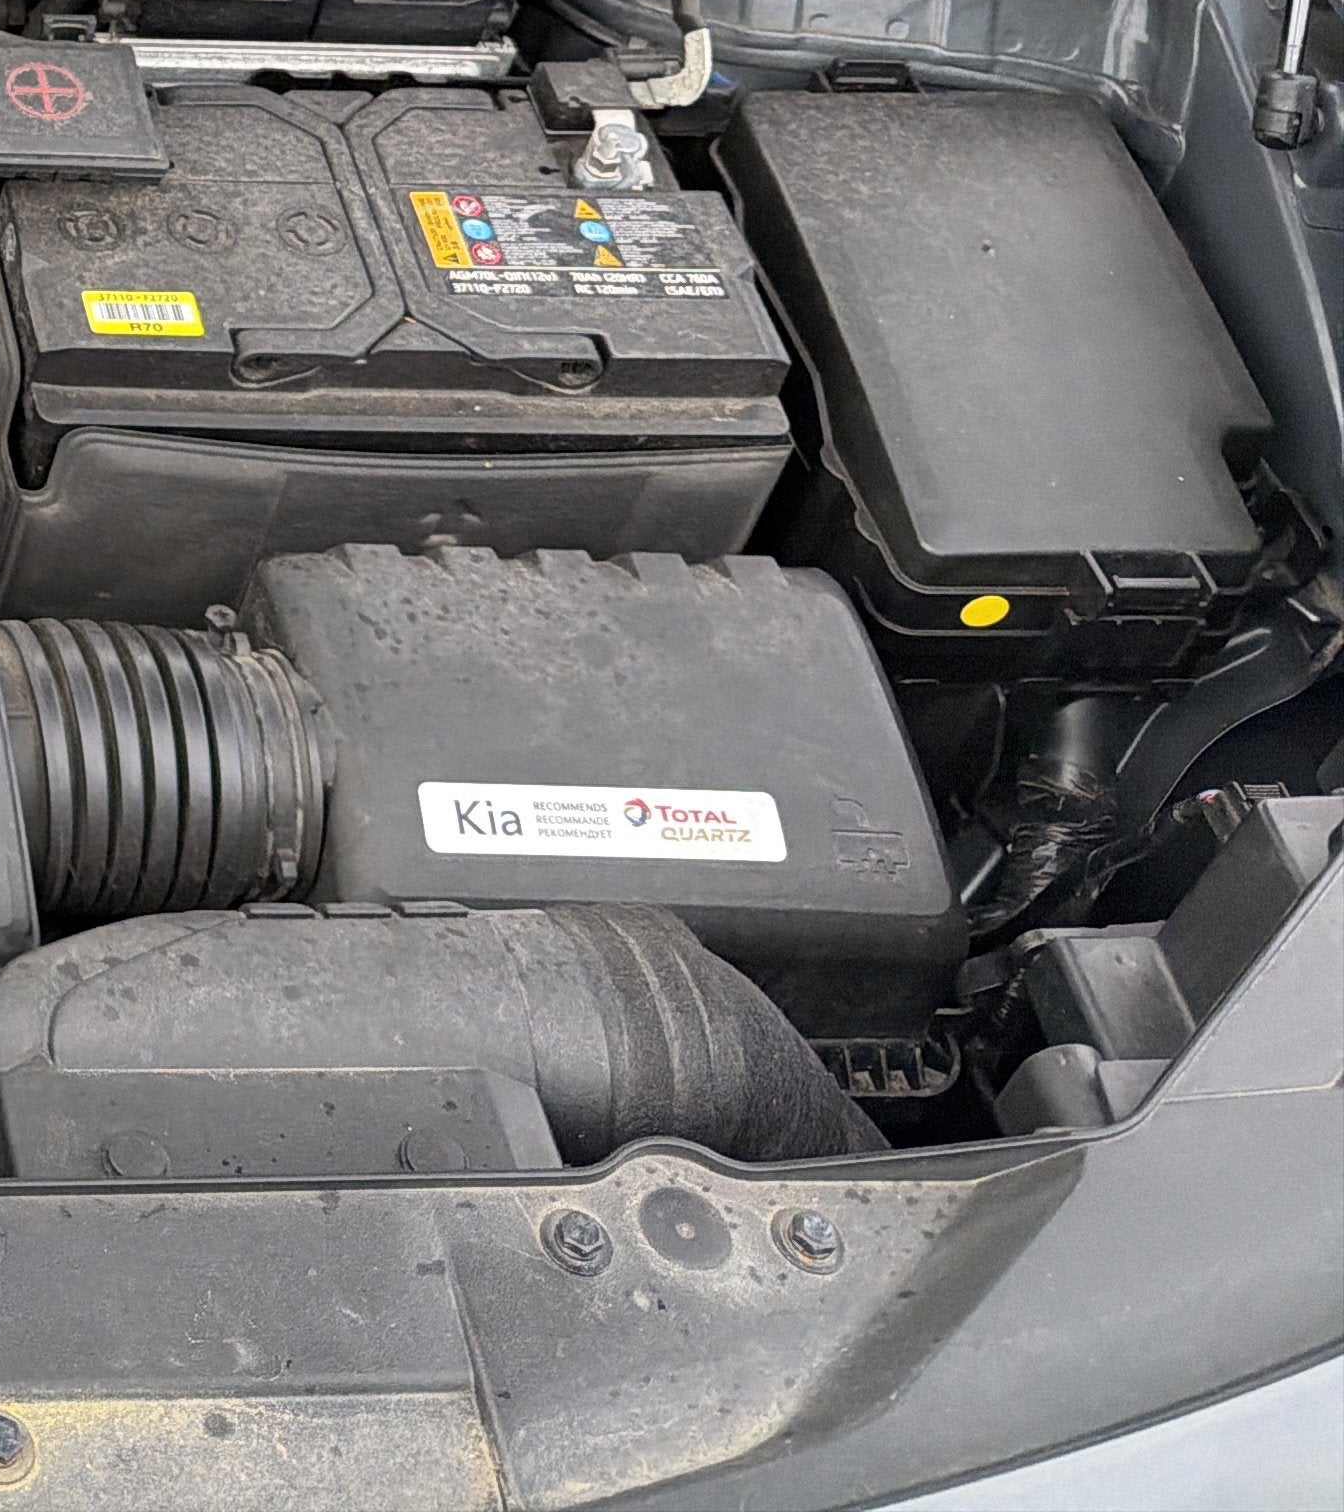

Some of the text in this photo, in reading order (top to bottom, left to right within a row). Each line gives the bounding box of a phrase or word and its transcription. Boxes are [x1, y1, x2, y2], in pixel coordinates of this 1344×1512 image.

[129, 322, 164, 332] R70
[532, 801, 608, 813] RECOMMENDS
[453, 799, 524, 837] Kia
[535, 814, 611, 826] RECOMMANDE
[654, 804, 738, 825] TOTAL
[660, 826, 752, 843] QUARTZ
